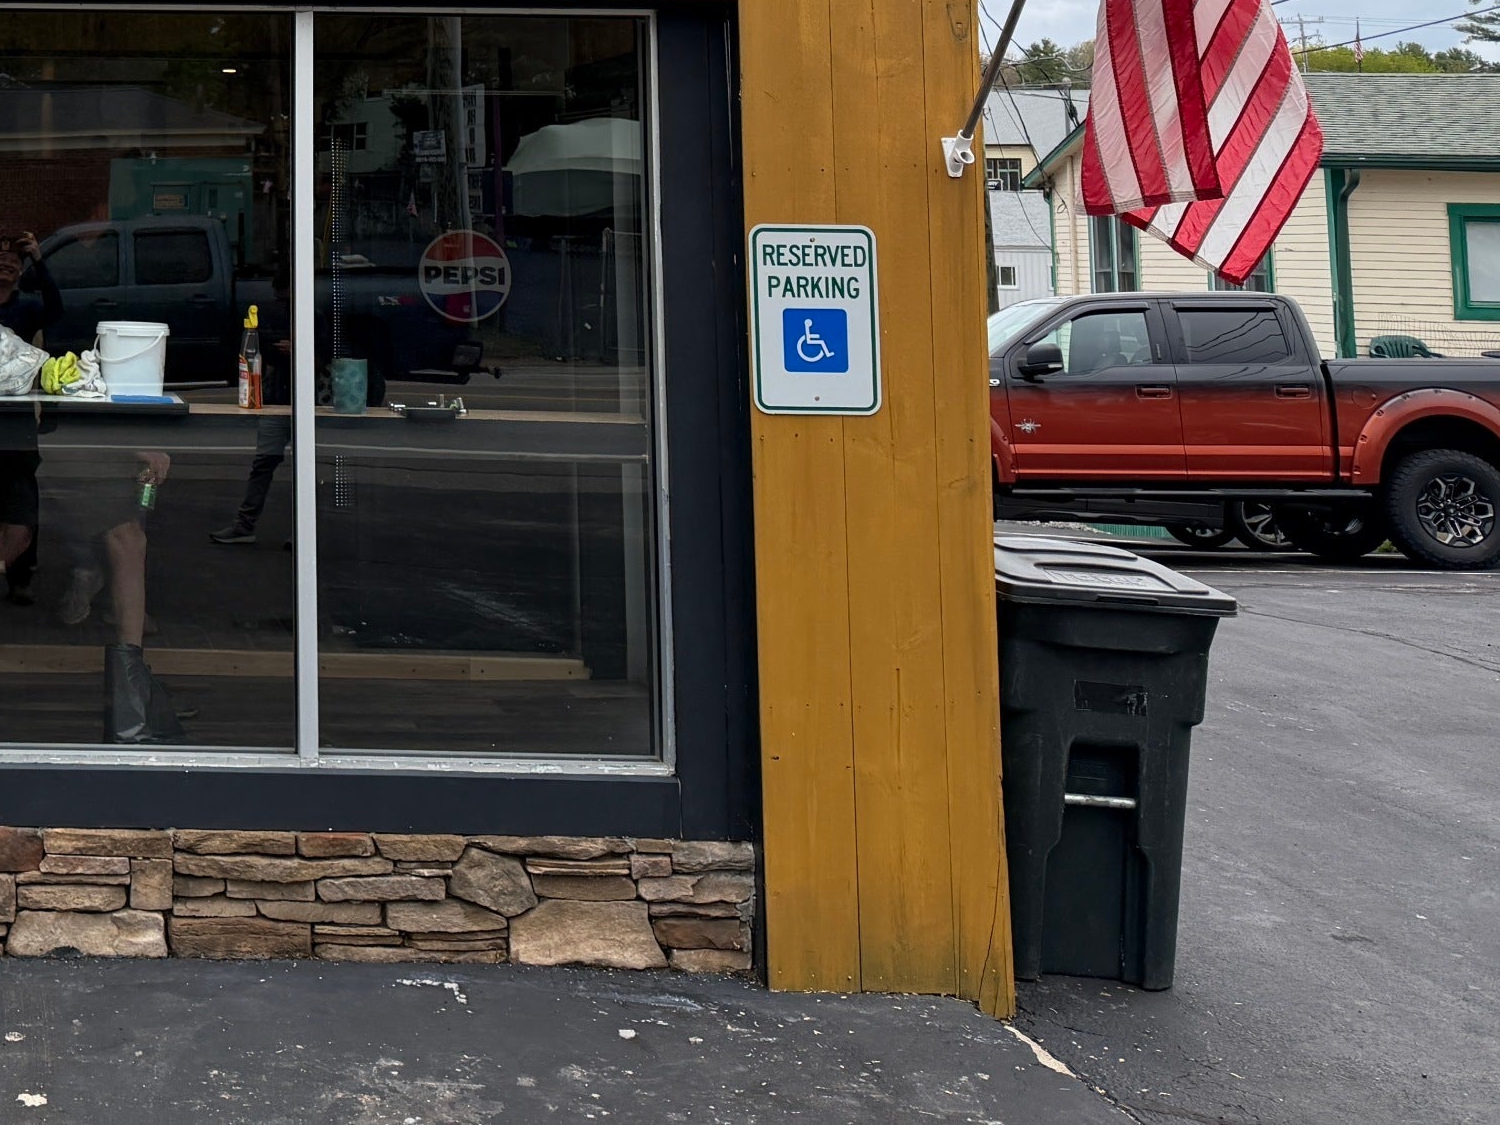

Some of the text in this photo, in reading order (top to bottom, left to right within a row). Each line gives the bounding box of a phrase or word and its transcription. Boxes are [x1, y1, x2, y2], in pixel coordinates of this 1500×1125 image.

[762, 244, 867, 268] RESERVED
[423, 266, 505, 286] PEPSI
[767, 276, 860, 299] PARKING
